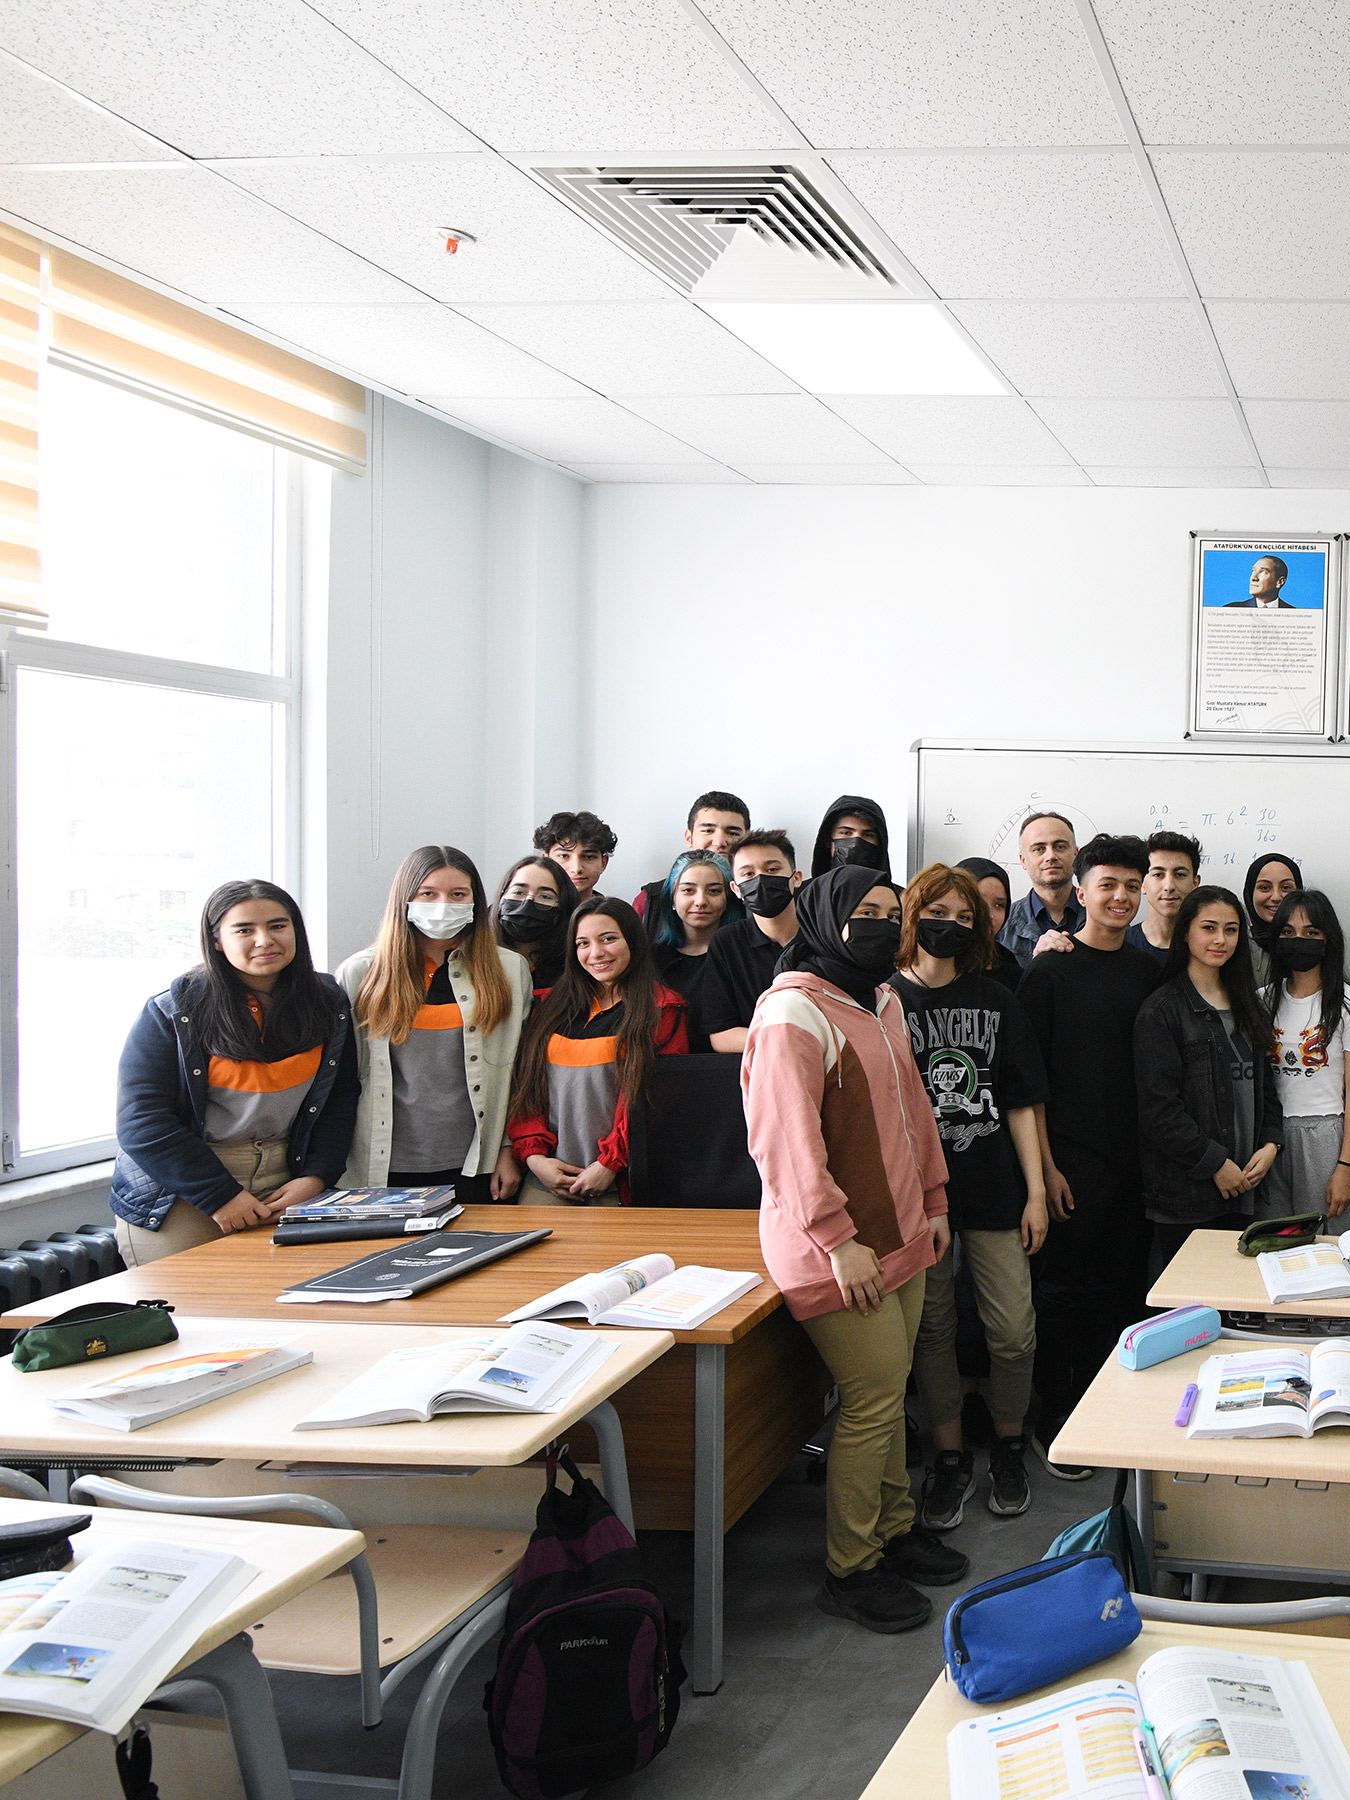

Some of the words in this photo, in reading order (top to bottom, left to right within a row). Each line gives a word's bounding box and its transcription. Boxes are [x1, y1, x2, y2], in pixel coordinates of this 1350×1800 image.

[1213, 542, 1253, 550] ATATÜRK'ÜN
[1254, 543, 1286, 551] GENÇLİĞE
[933, 1069, 963, 1082] KINGS
[560, 1637, 609, 1650] PARKOUR
